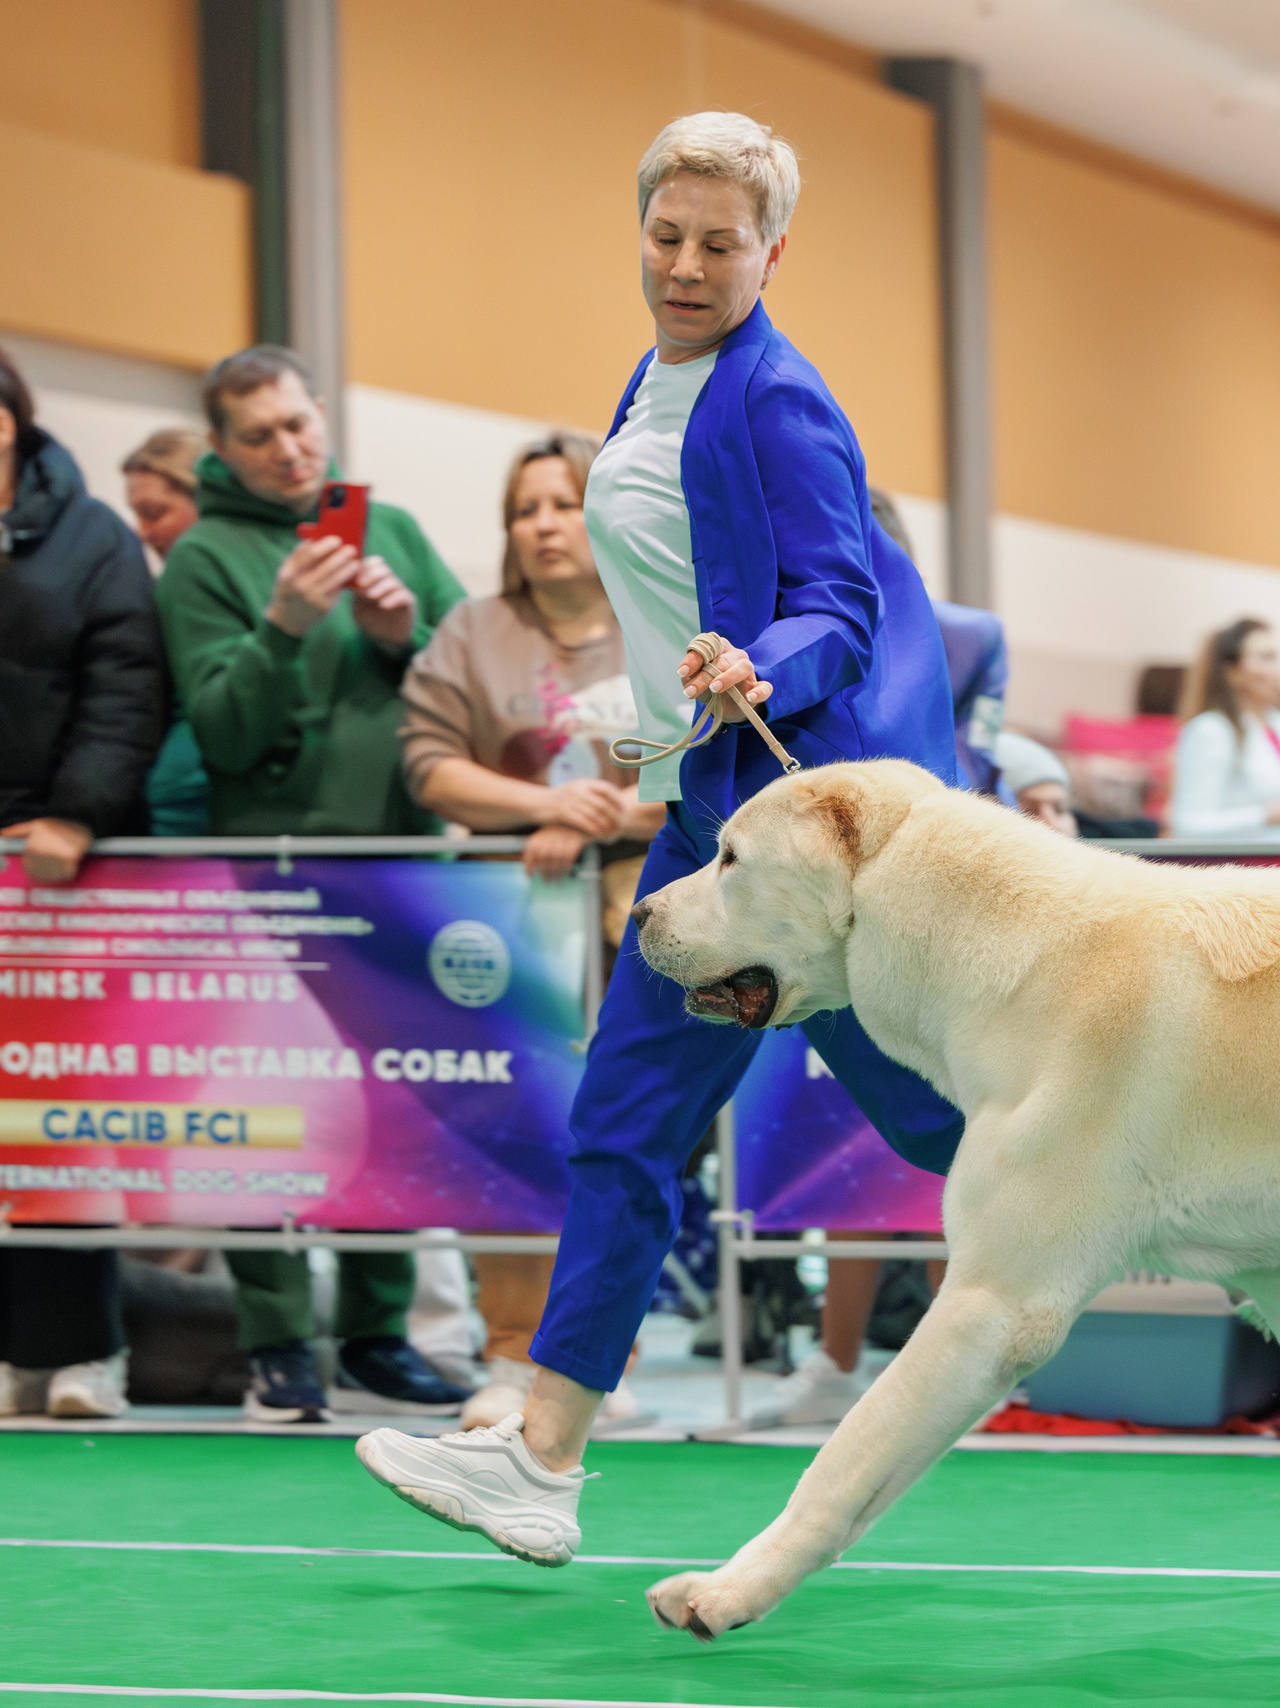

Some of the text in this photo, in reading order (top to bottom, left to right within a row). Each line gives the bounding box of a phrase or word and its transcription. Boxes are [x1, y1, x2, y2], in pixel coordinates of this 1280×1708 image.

[131, 970, 297, 1002] BELARUS
[0, 1041, 514, 1083] ОДНАЯ ВЫСТАВКА СОБАК
[42, 1108, 247, 1144] CACIB FCI
[172, 1167, 237, 1193] DOG
[246, 1170, 328, 1196] SHOW
